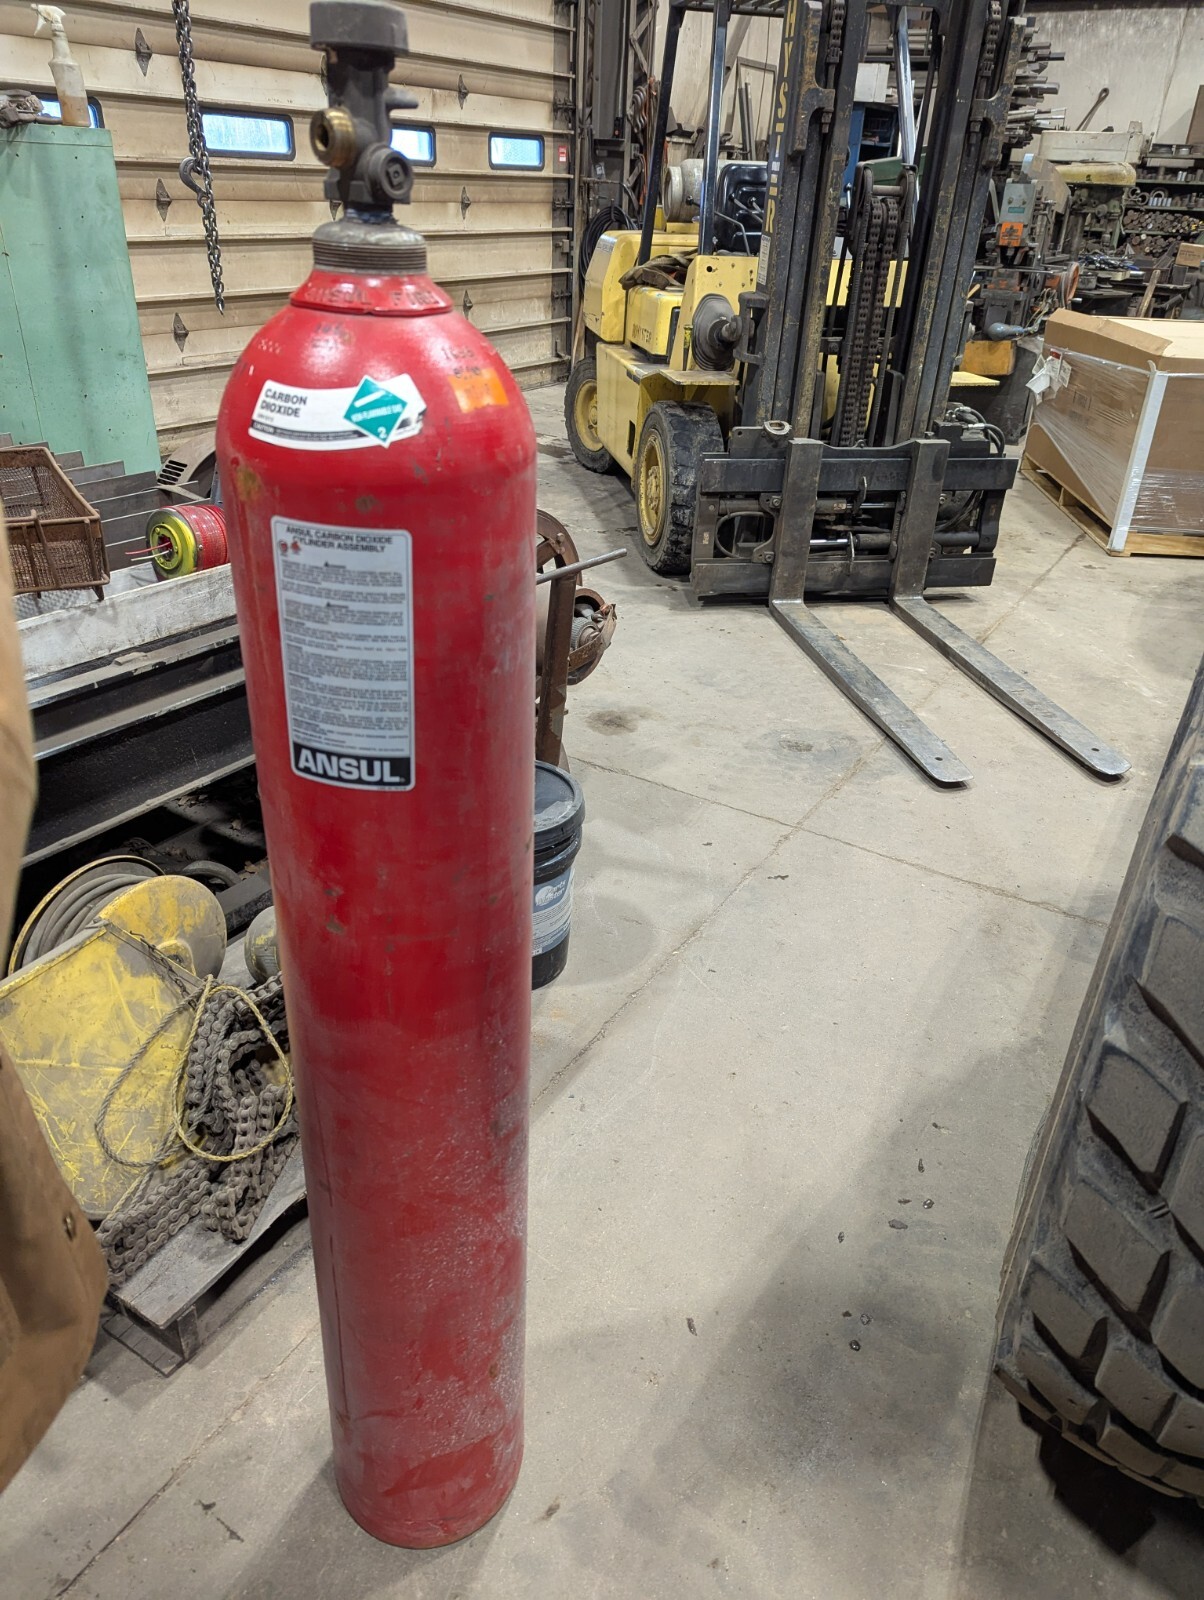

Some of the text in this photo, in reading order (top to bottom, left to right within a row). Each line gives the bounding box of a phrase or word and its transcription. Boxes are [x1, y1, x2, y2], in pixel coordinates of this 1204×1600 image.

[264, 388, 308, 406] CARBON
[260, 400, 301, 418] DIOXIDE
[377, 426, 388, 439] 2
[314, 531, 354, 542] CARBON
[356, 534, 393, 545] DIOXIDE
[336, 543, 386, 553] ASSEMBLY
[298, 748, 401, 783] ANSUL
